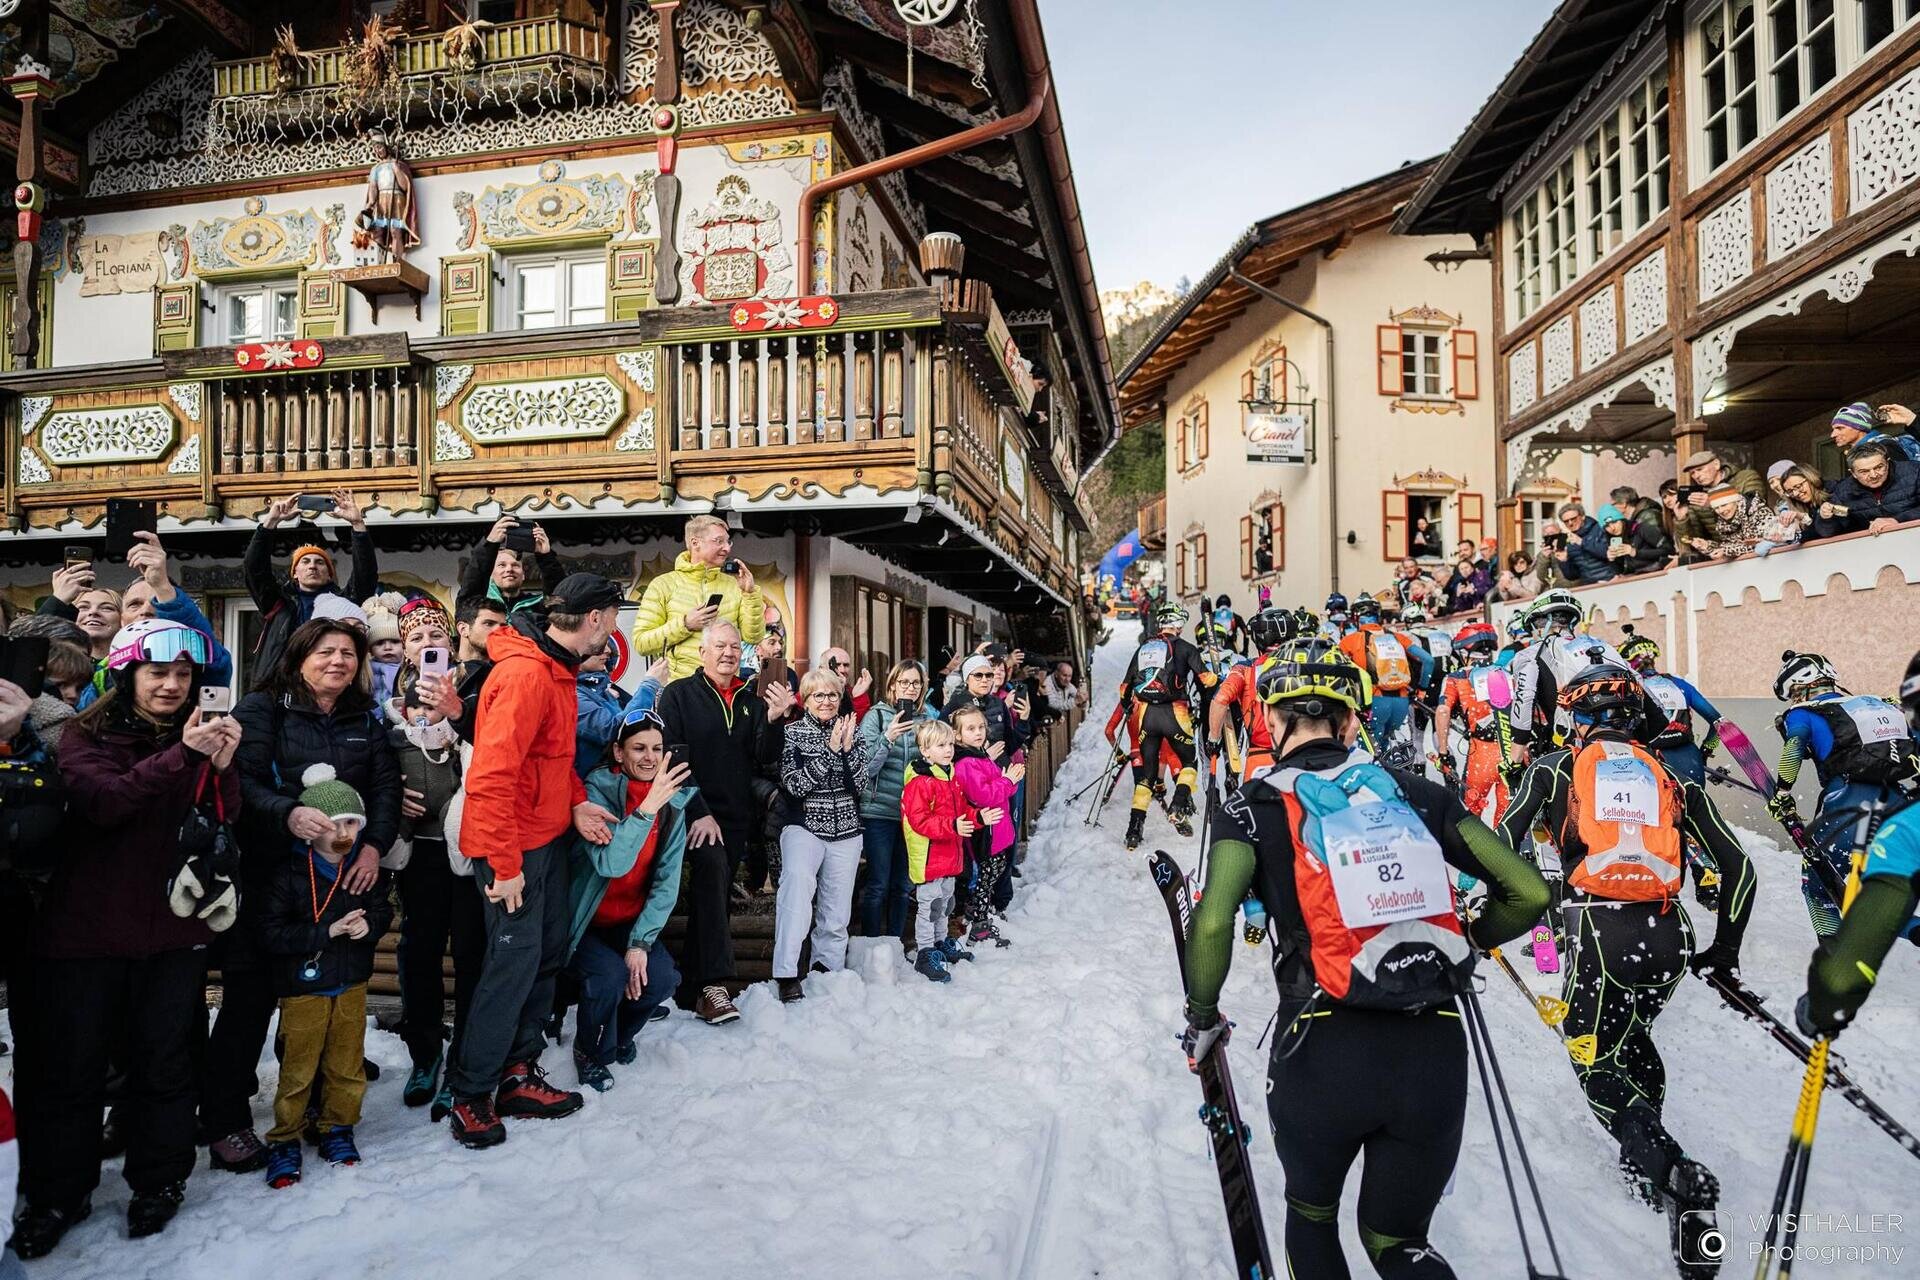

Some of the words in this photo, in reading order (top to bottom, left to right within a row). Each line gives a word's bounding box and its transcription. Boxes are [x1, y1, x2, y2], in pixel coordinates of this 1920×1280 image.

[1556, 679, 1626, 706] SCOTT
[1877, 716, 1890, 725] 10
[1613, 792, 1632, 804] 41
[1602, 806, 1647, 821] SellaRonda
[1361, 844, 1389, 855] ANDREA
[1363, 852, 1398, 864] LUSUARDI
[1378, 862, 1405, 883] 82
[1599, 873, 1655, 882] CAMP
[1367, 887, 1425, 911] SellaRonda
